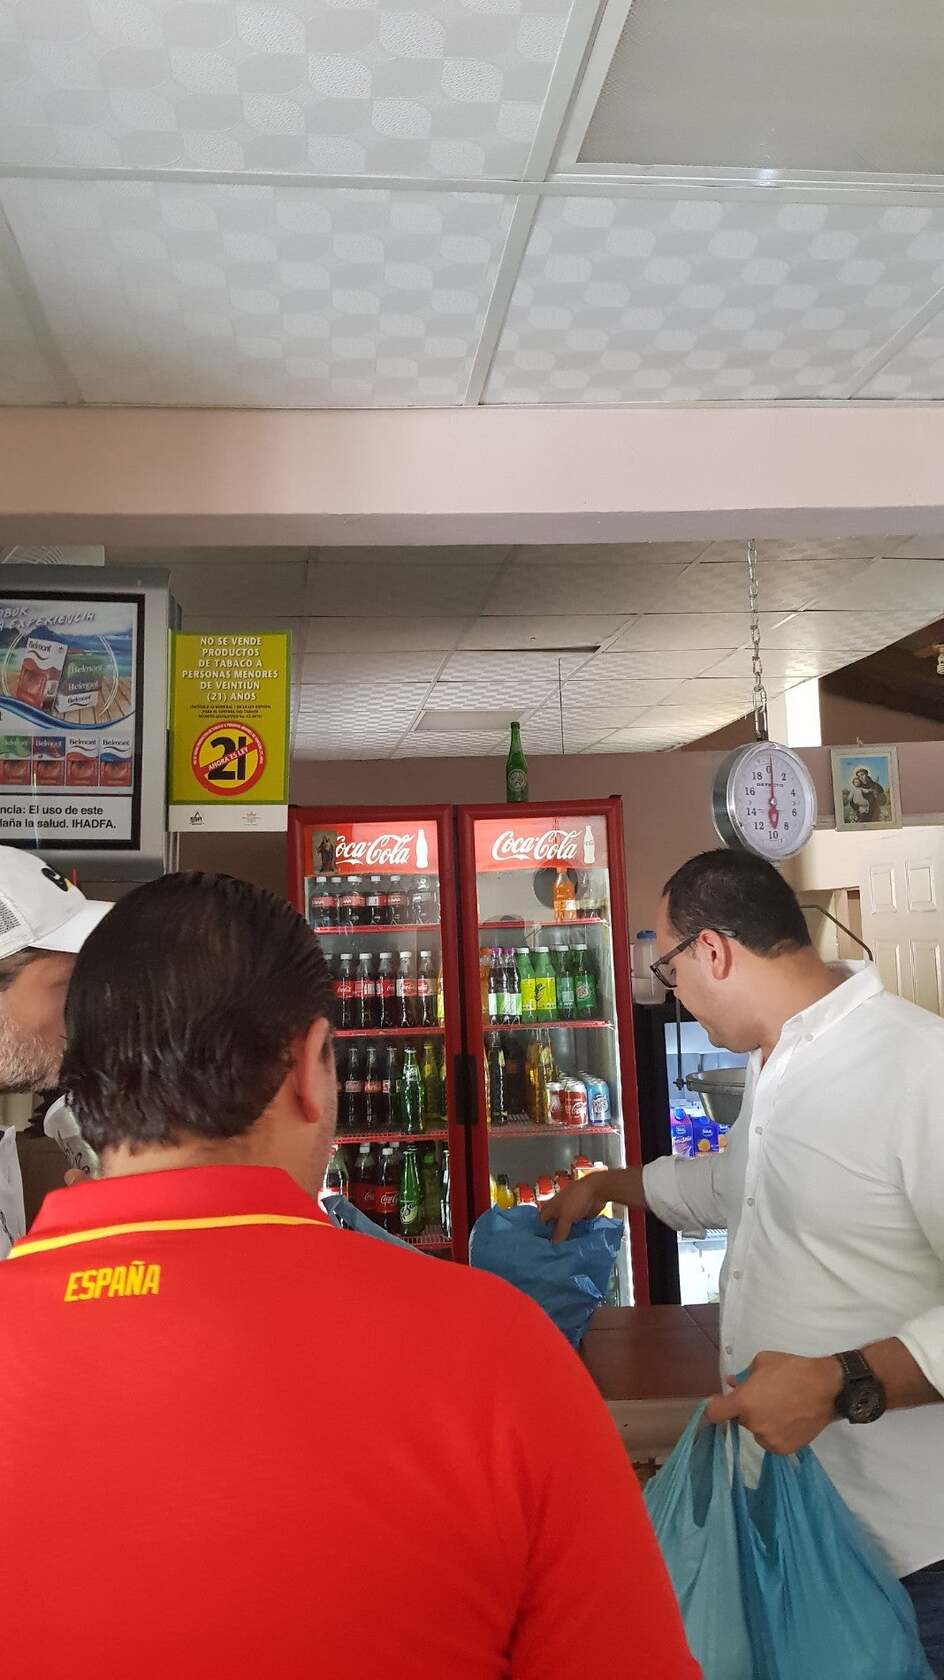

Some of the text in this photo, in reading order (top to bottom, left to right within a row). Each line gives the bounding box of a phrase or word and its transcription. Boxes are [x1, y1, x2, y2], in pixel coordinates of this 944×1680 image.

[200, 637, 262, 646] NO SE VENDE
[202, 648, 260, 657] PRODUCTOS
[199, 659, 262, 668] DE TABACO A
[182, 670, 278, 679] PERSONAS MENORES
[200, 681, 212, 690] DE
[207, 692, 227, 702] (21)
[207, 736, 247, 780] 21
[208, 756, 230, 771] AHORA
[237, 747, 248, 757] LEY
[752, 772, 763, 780] 18
[781, 773, 787, 781] 2
[745, 787, 755, 796] 16
[791, 789, 796, 797] 4
[29, 805, 39, 814] El
[42, 807, 62, 815] uso
[65, 806, 78, 815] de
[81, 806, 103, 815] este
[747, 807, 757, 816] 14
[792, 808, 797, 817] 6
[25, 819, 34, 828] la
[37, 819, 69, 828] salud.
[72, 819, 117, 829] IHADFA.
[754, 822, 764, 830] 12
[784, 822, 789, 830] 8
[768, 831, 779, 840] 10
[335, 834, 414, 865] oca-Cola
[492, 829, 583, 861] Coca-Cola
[64, 1260, 161, 1303] ESPAÑA
